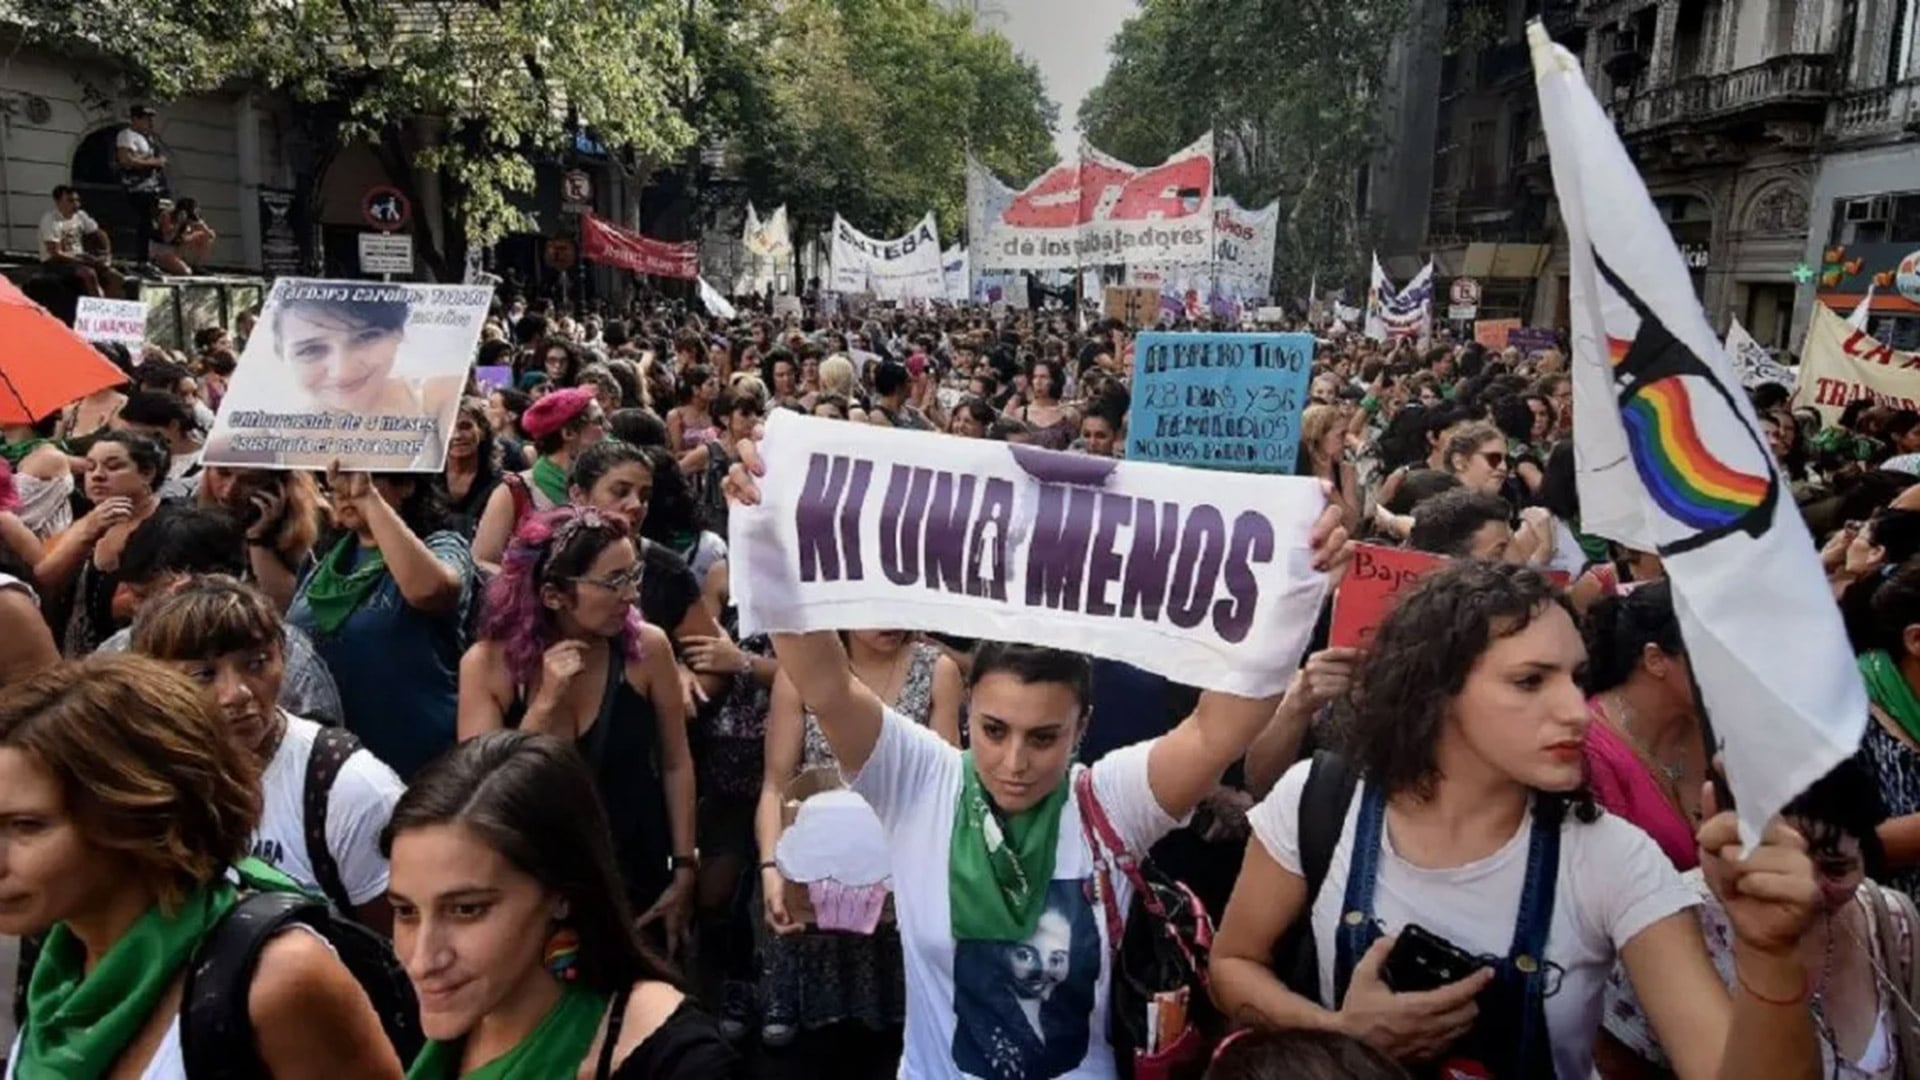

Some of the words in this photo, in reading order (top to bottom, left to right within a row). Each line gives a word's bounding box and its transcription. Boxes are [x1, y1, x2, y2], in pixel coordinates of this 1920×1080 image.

[1003, 236, 1034, 256] de
[1039, 236, 1071, 256] los
[1249, 342, 1305, 373] TUVO
[1843, 328, 1894, 365] LA
[1145, 381, 1178, 410] 28
[795, 453, 873, 583] NI
[879, 463, 1015, 603] UNA
[1025, 480, 1275, 645] MENOS
[1355, 552, 1418, 592] Bajo
